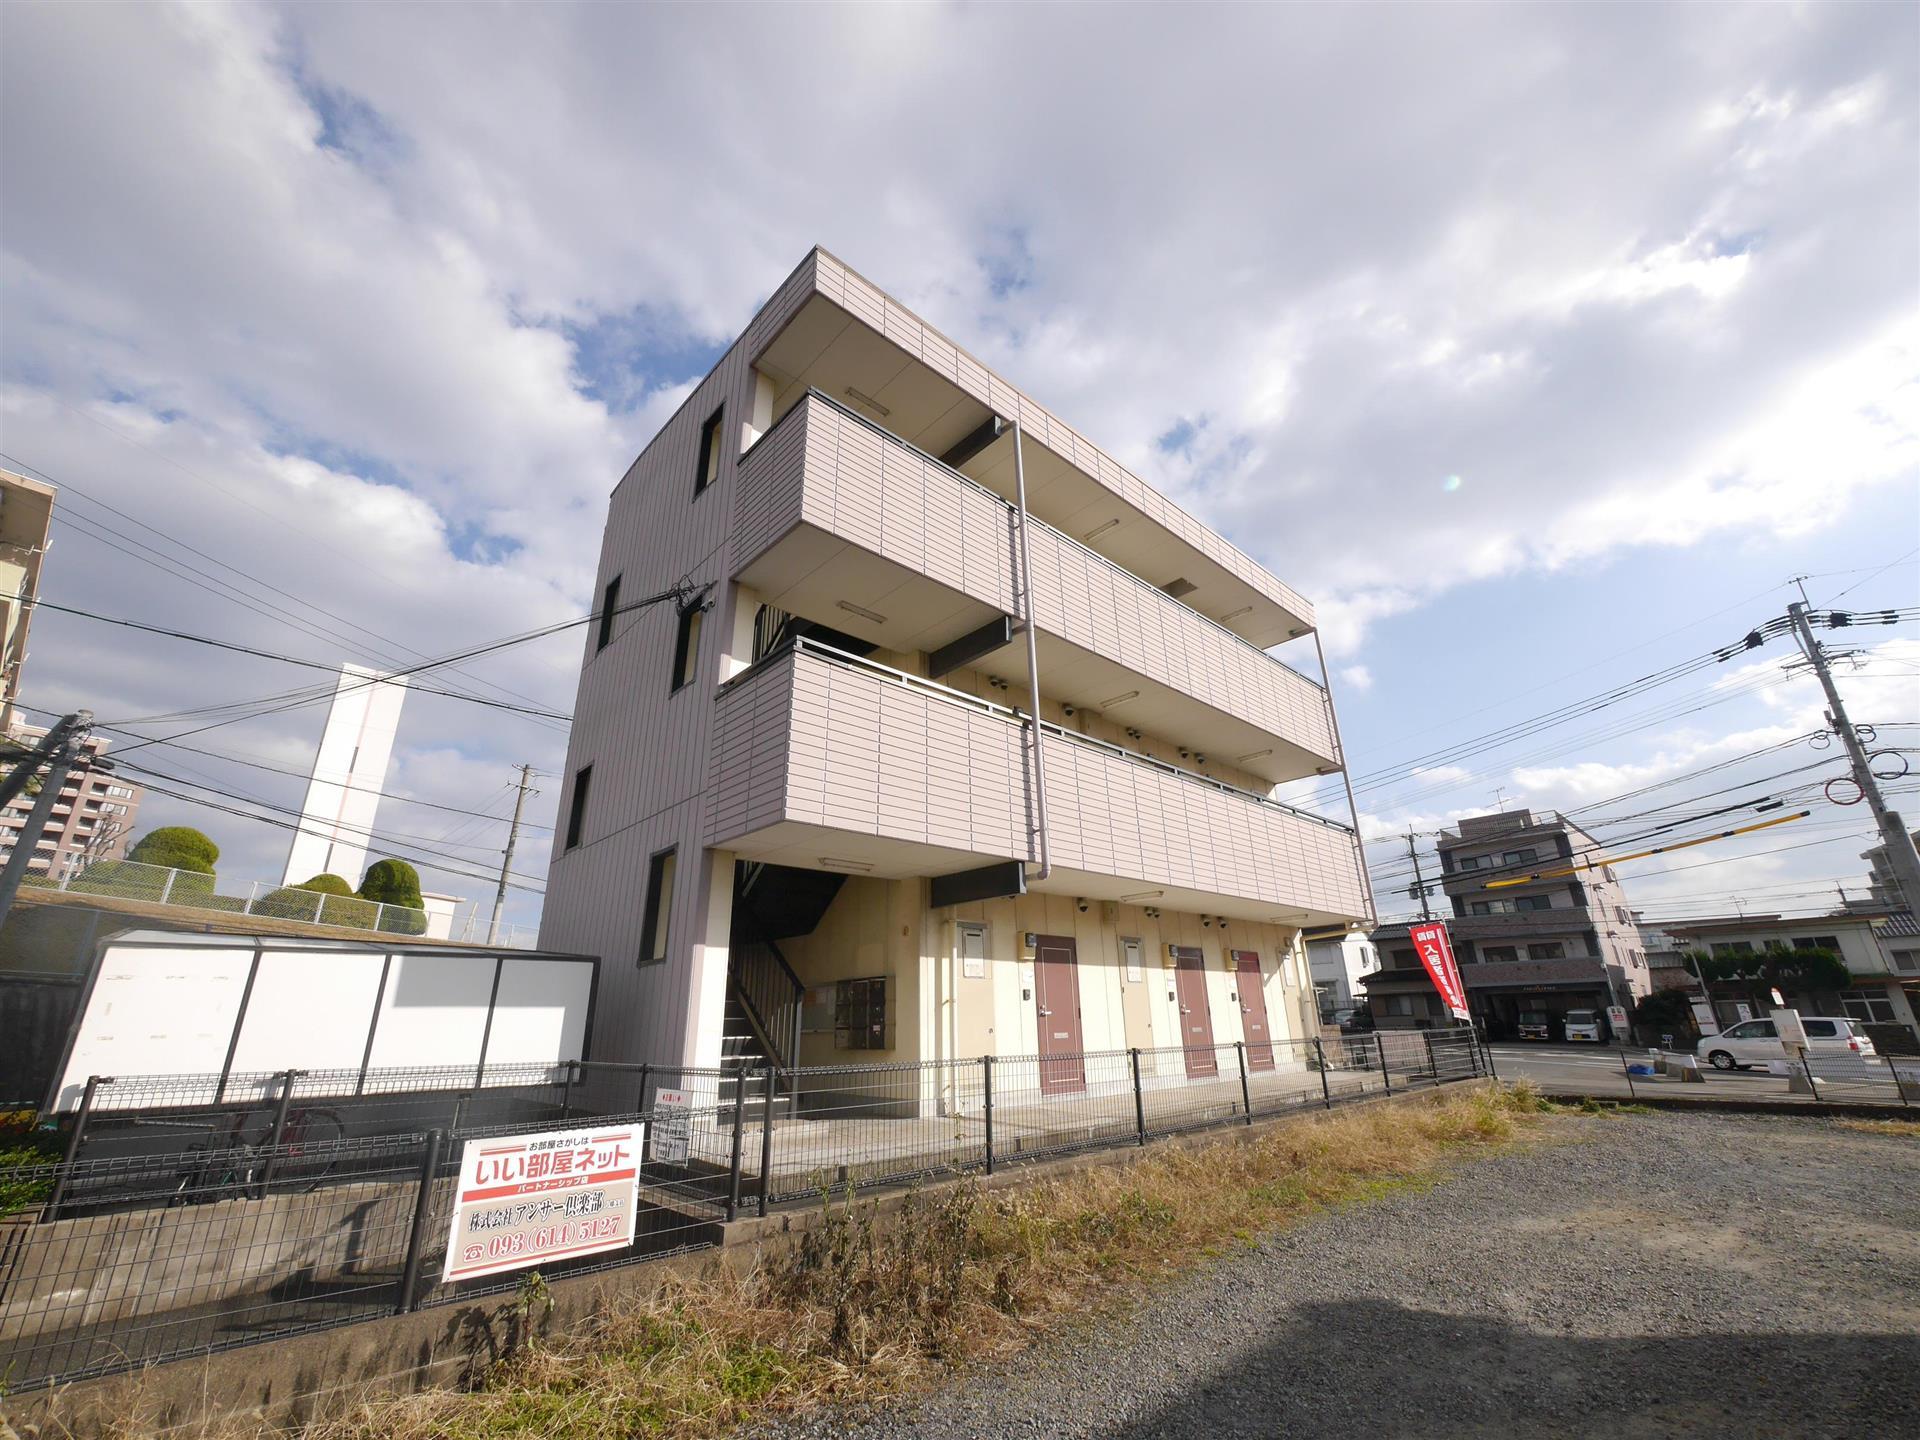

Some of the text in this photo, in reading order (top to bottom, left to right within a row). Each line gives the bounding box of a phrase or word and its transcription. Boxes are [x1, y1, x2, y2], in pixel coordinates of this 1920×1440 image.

[529, 1137, 589, 1151] お部屋さがしは
[476, 1144, 630, 1185] いい部屋ネット
[518, 1176, 589, 1193] パートナーシップ店
[488, 1216, 622, 1258] 093(614)5127
